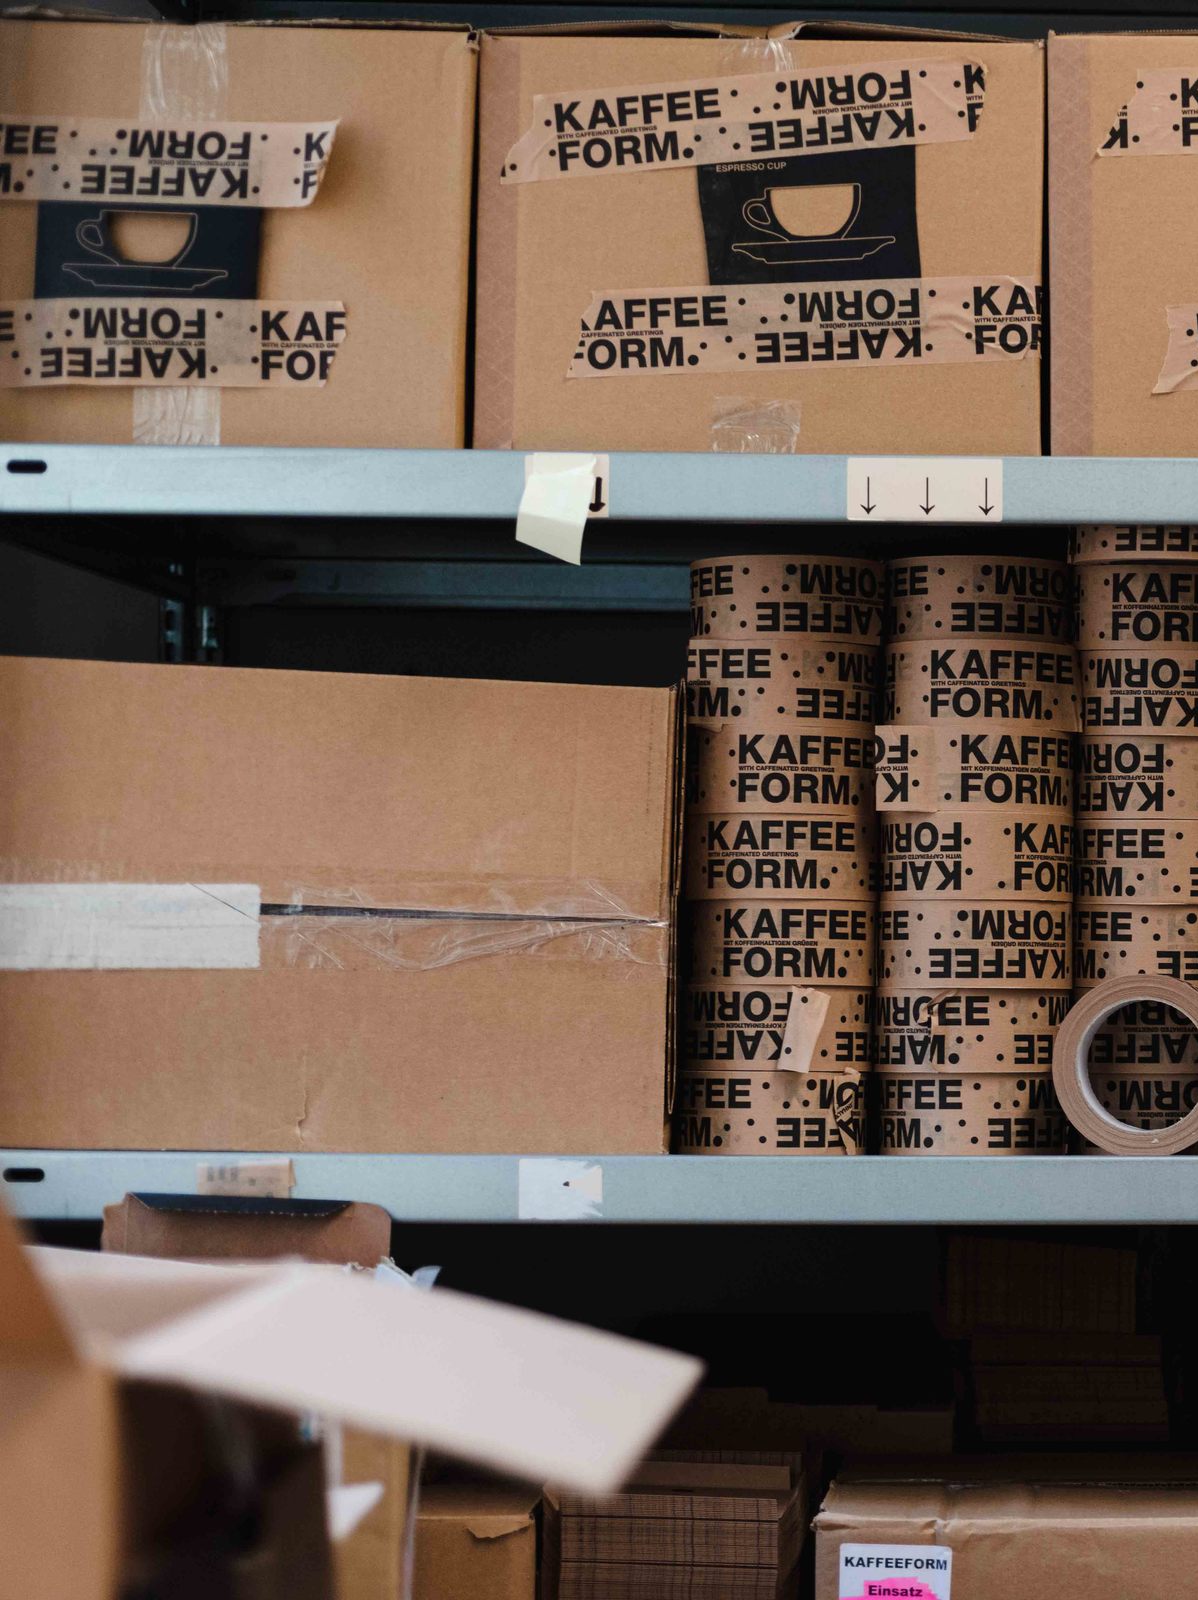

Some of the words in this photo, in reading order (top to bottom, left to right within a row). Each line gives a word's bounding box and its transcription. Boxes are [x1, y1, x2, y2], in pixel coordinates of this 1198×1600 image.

[554, 88, 721, 133] KAFFEE
[575, 128, 619, 138] CAFFEINATED
[620, 125, 657, 134] GREETINGS
[748, 108, 915, 152] KAFFEE
[81, 164, 248, 198] KAFFEE
[716, 163, 765, 172] ESPRESSO
[767, 162, 786, 170] CUP
[754, 327, 922, 363] KAFFEE
[40, 348, 206, 379] KAFFEE
[931, 650, 1074, 685] KAFFEE
[708, 820, 855, 852] KAFFEE
[724, 909, 866, 940] KAFFEE
[929, 949, 1066, 979] KAFFEE
[845, 1557, 947, 1570] KAFFEEFORM
[868, 1585, 922, 1597] Einsatz
